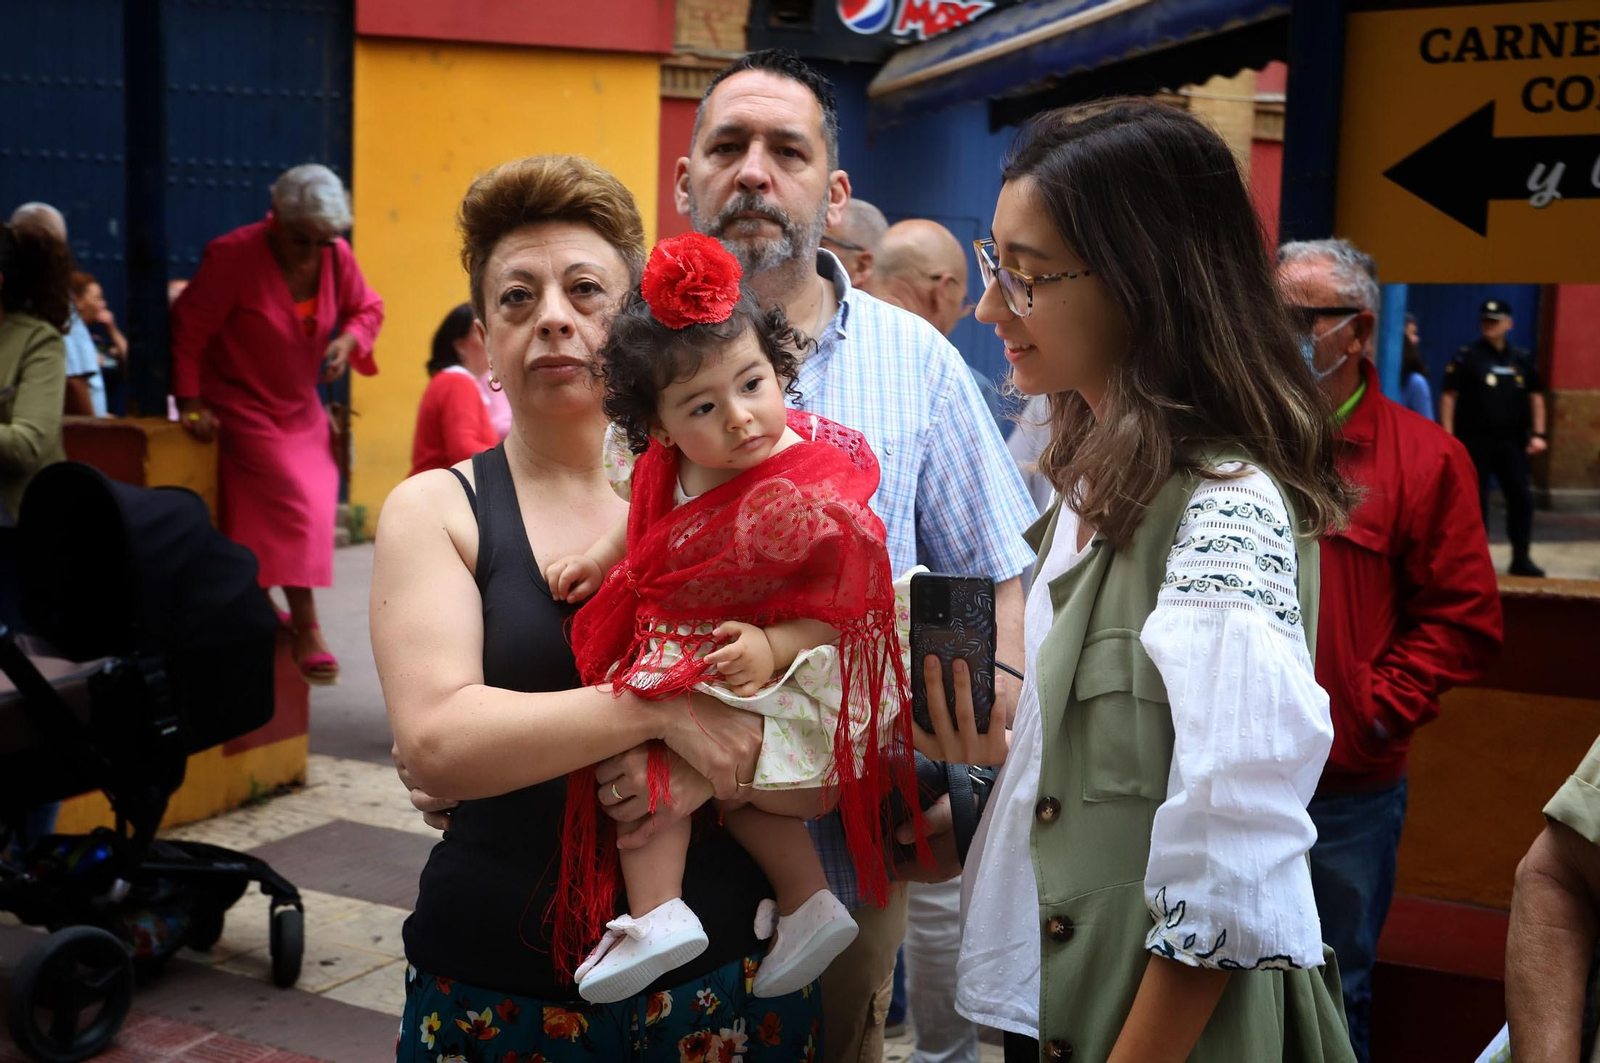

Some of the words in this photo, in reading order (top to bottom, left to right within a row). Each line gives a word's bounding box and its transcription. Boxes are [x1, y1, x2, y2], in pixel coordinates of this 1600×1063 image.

[1420, 20, 1600, 63] CARNE
[1522, 75, 1600, 113] CO
[1527, 161, 1566, 208] y
